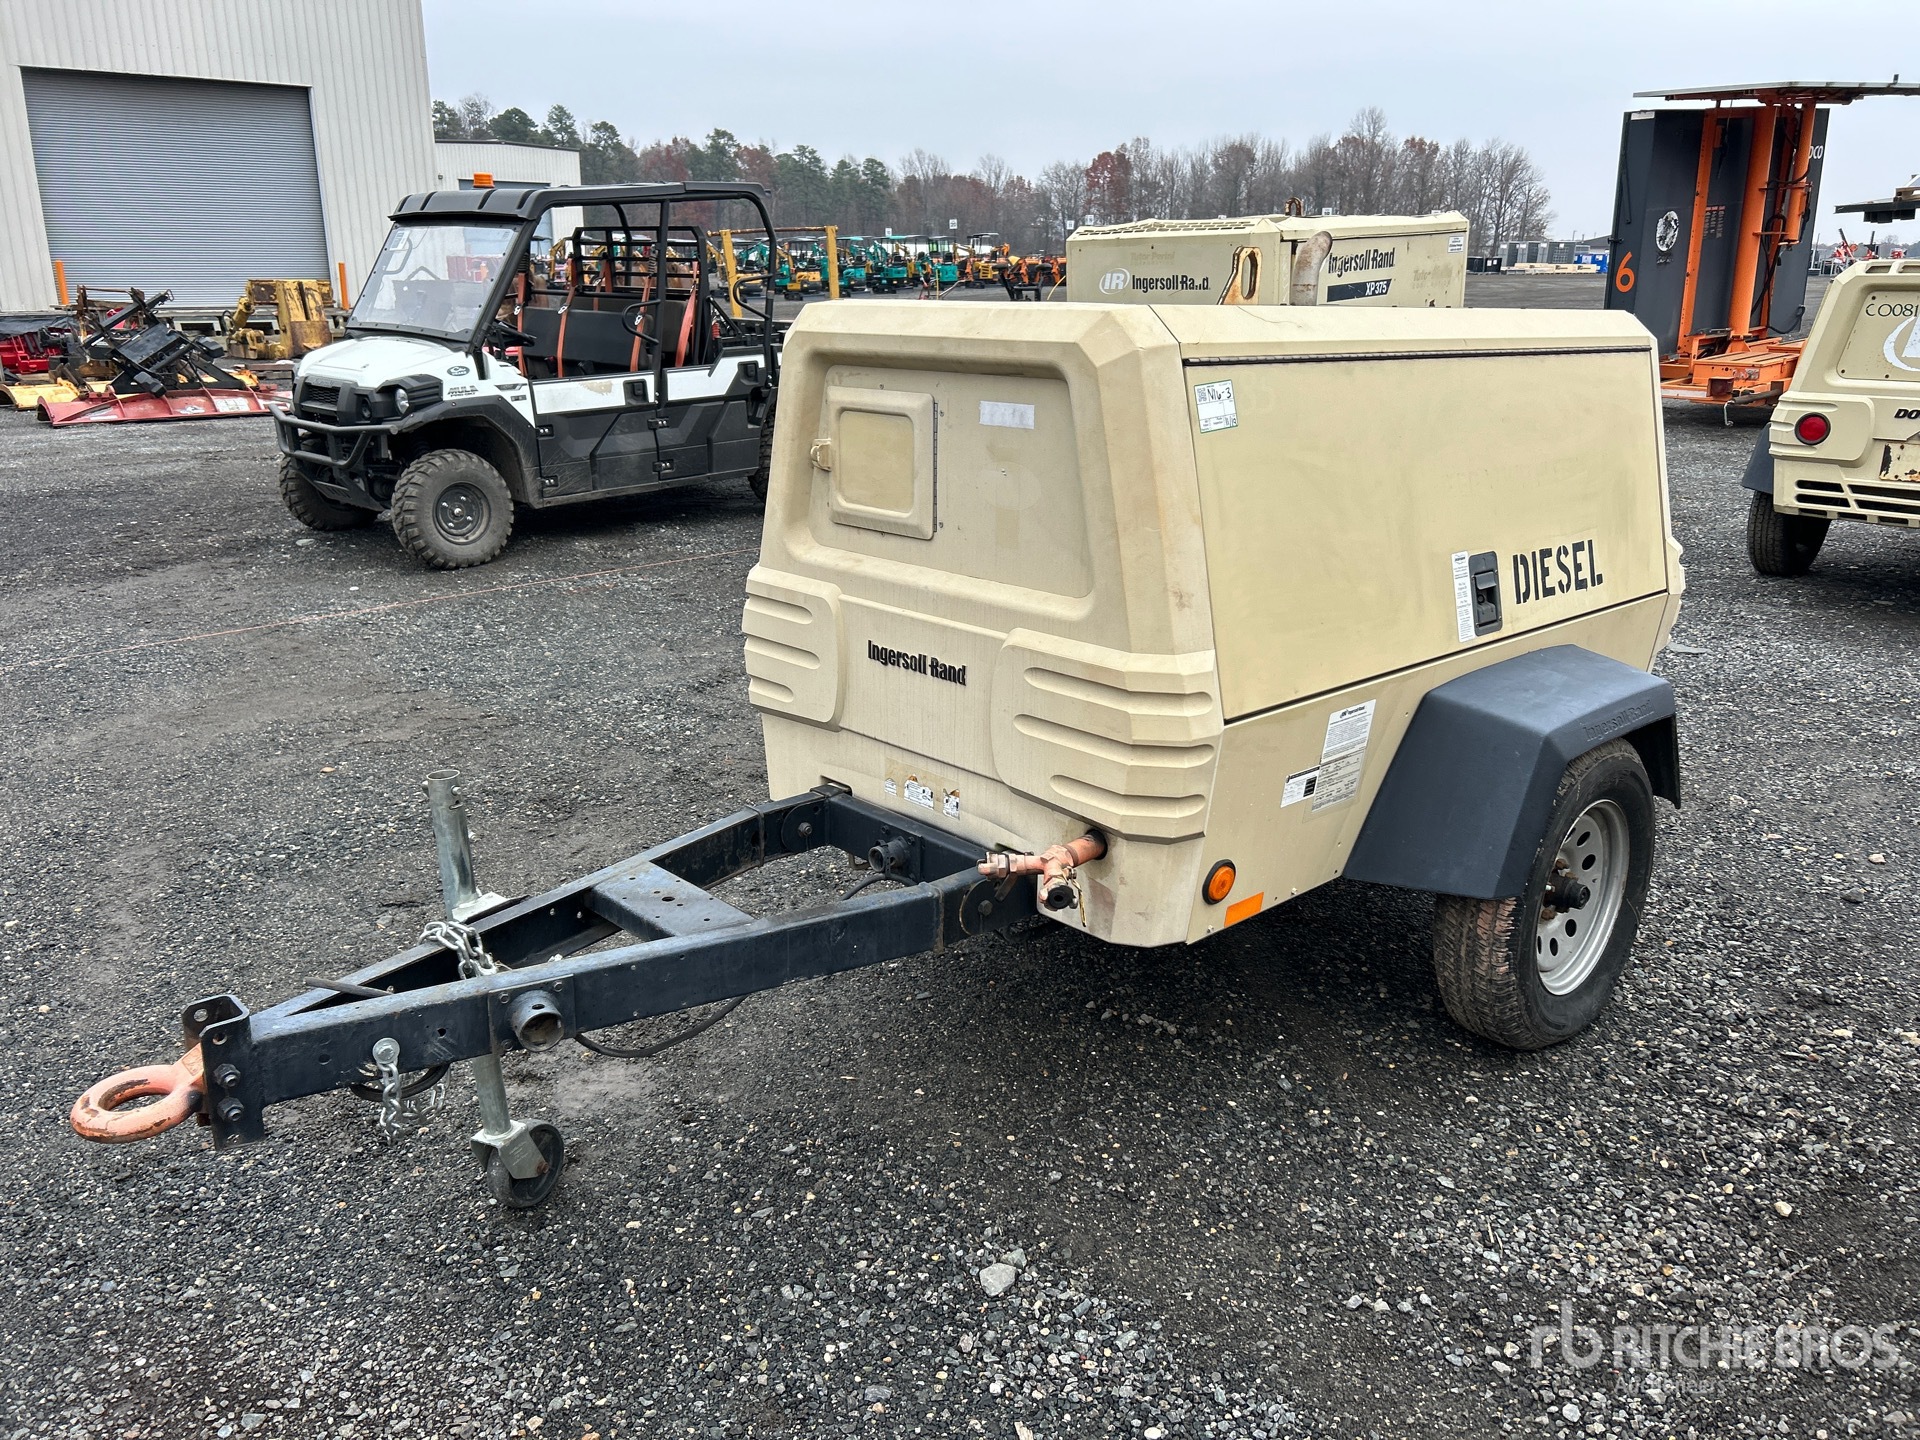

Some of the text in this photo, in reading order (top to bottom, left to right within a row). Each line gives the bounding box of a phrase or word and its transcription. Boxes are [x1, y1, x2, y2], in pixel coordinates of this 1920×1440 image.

[1328, 247, 1395, 278] Ingersoll Rand
[1615, 251, 1635, 293] 6
[1132, 275, 1179, 293] Ingersoll
[1365, 281, 1388, 296] XP375
[1512, 539, 1604, 605] DIESEL
[867, 640, 967, 686] Ingersoll Rand
